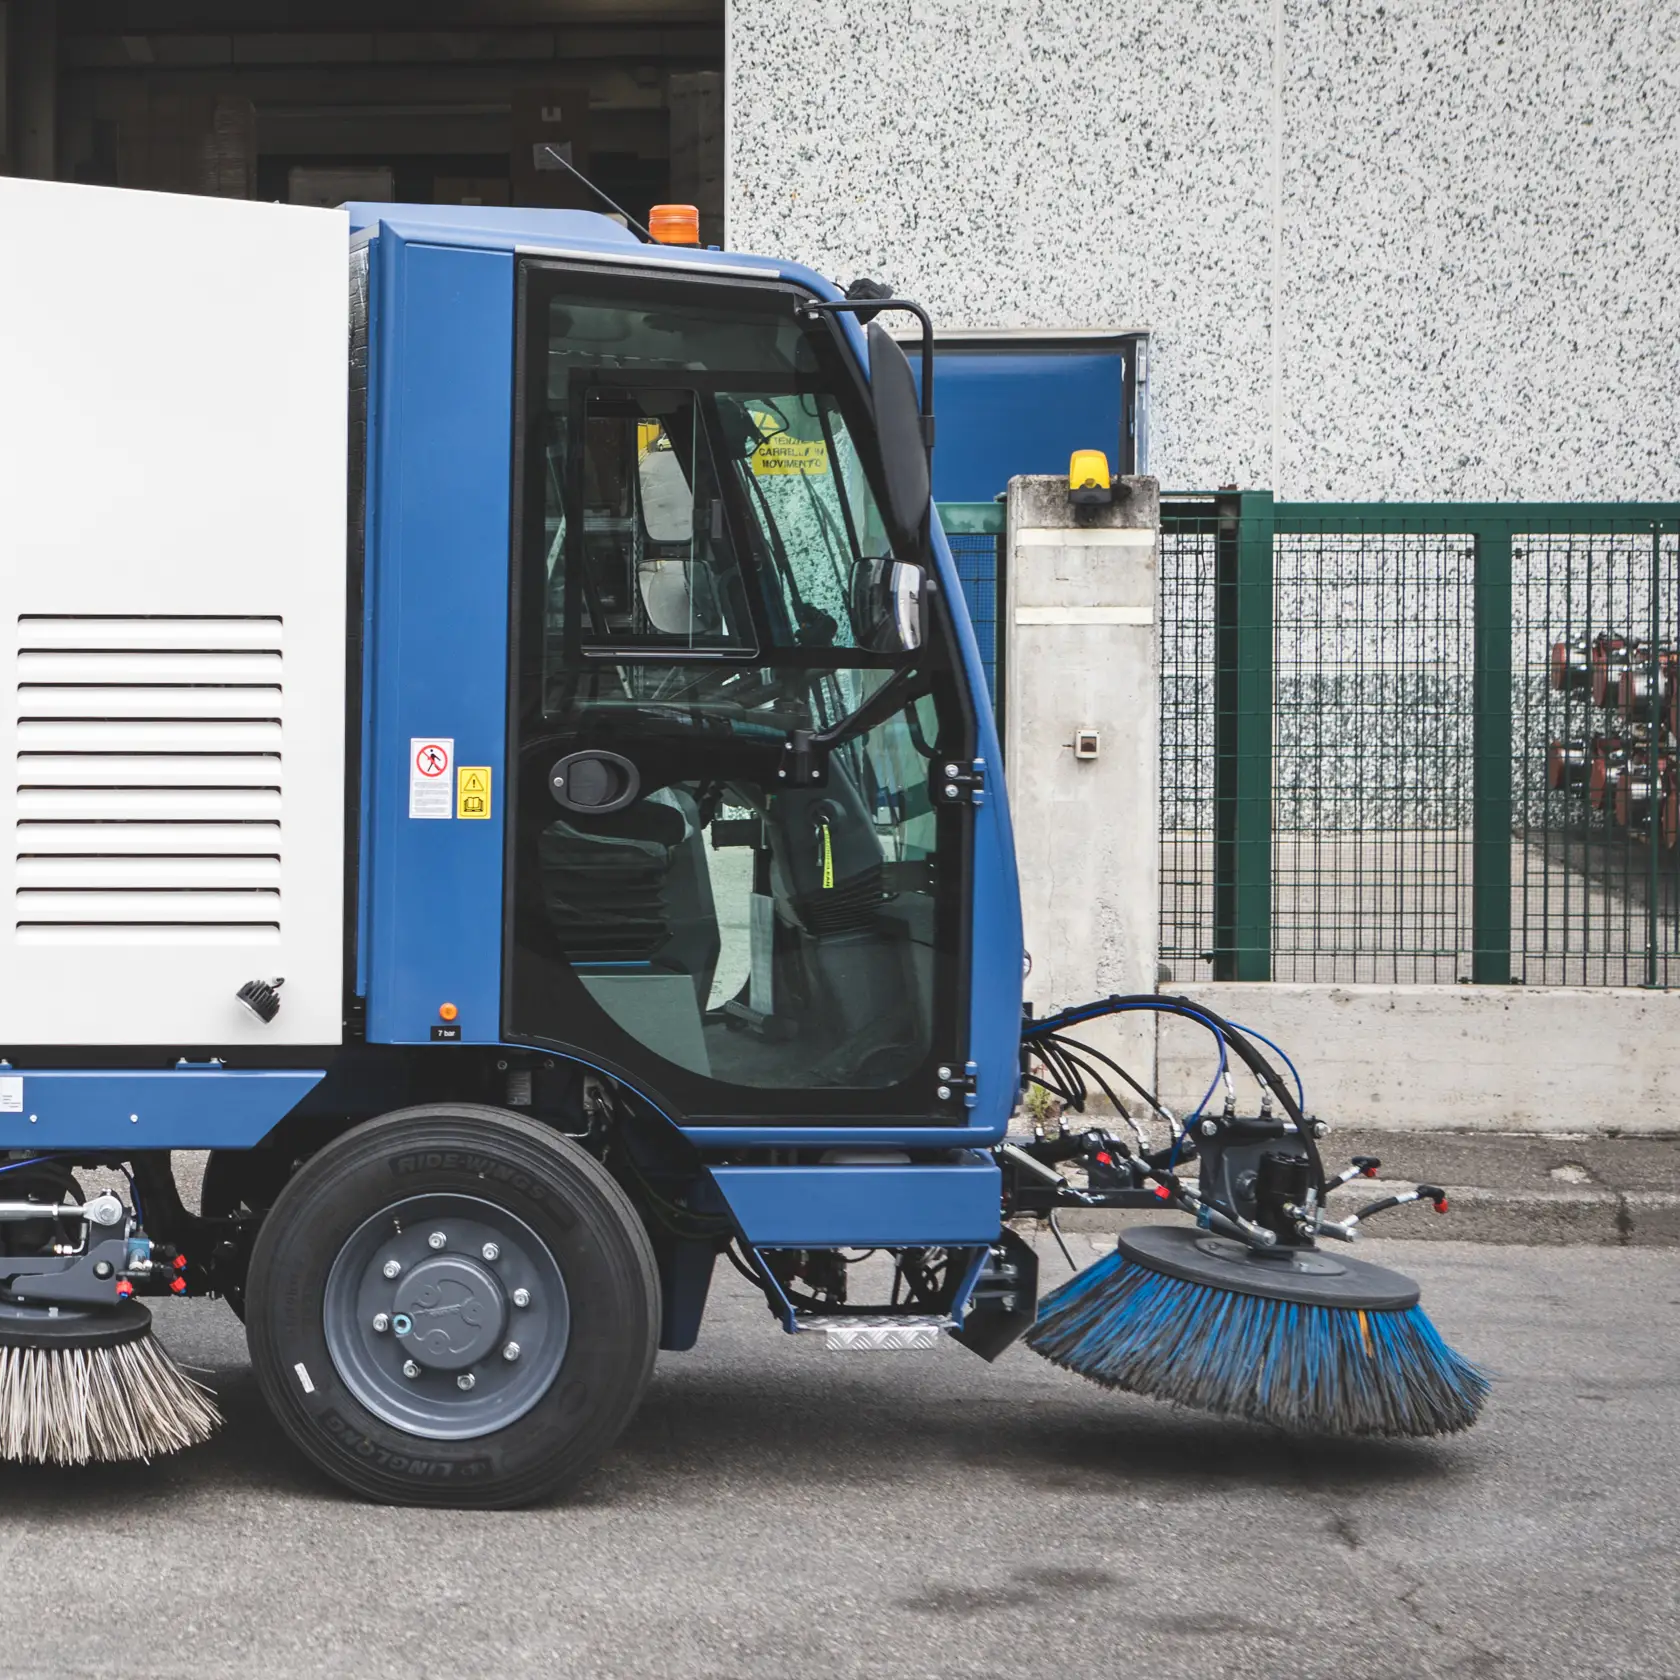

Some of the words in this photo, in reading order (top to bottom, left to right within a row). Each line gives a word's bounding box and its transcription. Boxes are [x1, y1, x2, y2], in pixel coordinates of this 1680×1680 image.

[762, 458, 822, 468] MOVIMENTO
[444, 1030, 456, 1038] bar
[325, 1415, 454, 1476] LINGLONG
